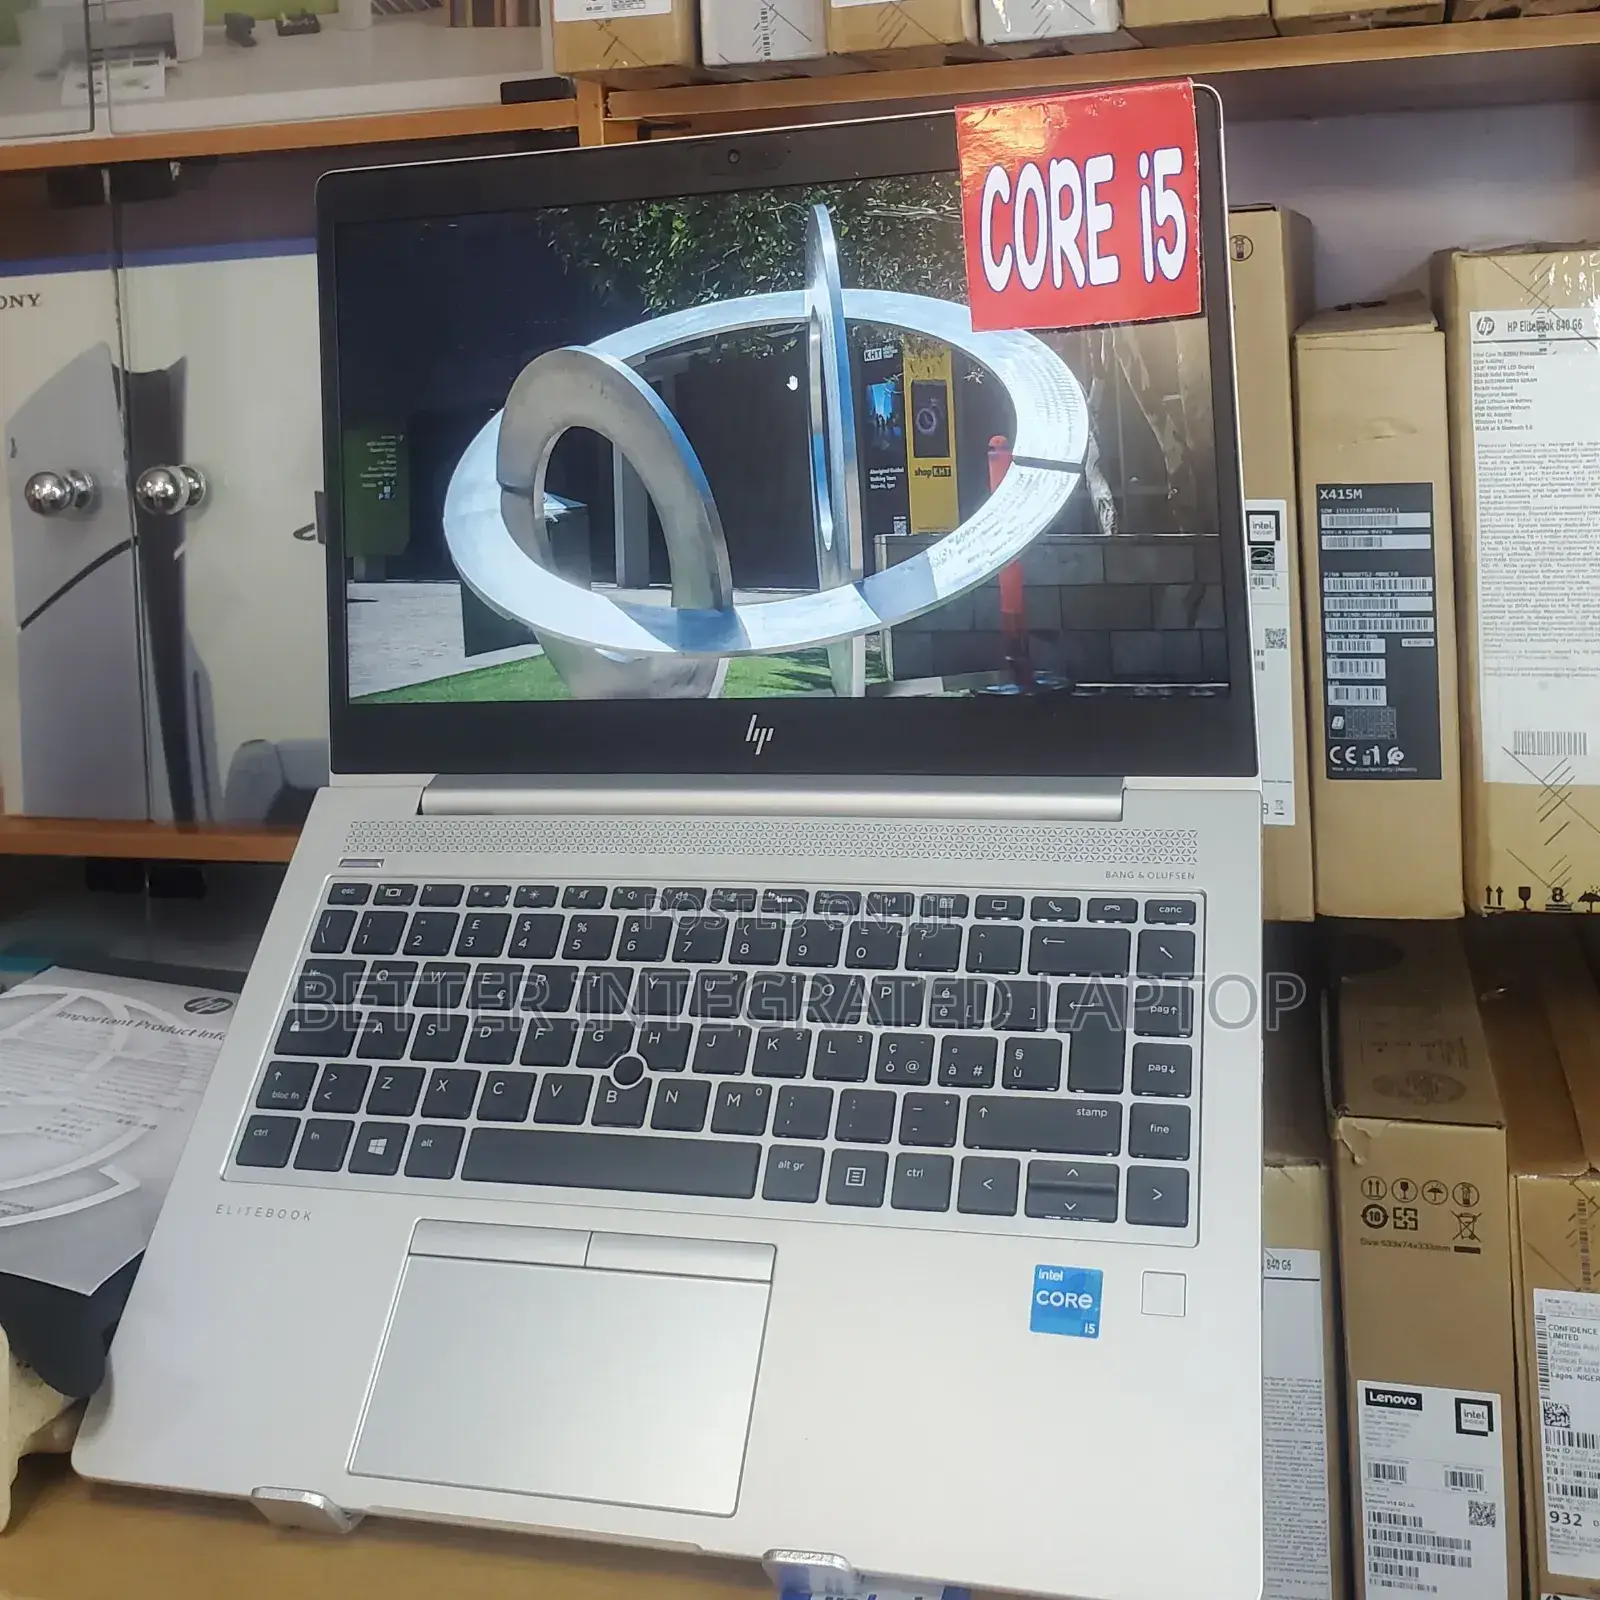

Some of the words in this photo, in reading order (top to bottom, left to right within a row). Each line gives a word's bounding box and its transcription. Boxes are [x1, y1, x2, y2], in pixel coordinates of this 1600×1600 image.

[980, 153, 1119, 292] CORE
[1138, 147, 1187, 283] i5
[1507, 321, 1518, 332] HP
[1556, 320, 1570, 331] 840
[1572, 319, 1583, 331] G6
[1320, 489, 1362, 500] X415M
[1105, 871, 1136, 879] BANG
[1138, 871, 1145, 879] &
[1147, 871, 1195, 880] OLUFSEN
[1159, 906, 1182, 914] canc
[362, 934, 368, 944] 1
[412, 936, 423, 946] 2
[465, 937, 475, 947] 3
[518, 938, 528, 949] 4
[572, 940, 581, 950] 5
[627, 940, 636, 951] 6
[683, 942, 692, 952] 7
[740, 943, 750, 954] 8
[798, 945, 807, 956] 9
[856, 947, 867, 958] 0
[376, 970, 388, 981] Q
[431, 971, 446, 983] W
[481, 972, 492, 984] E
[535, 975, 547, 987] R
[592, 977, 600, 988] T
[649, 977, 659, 990] Y
[704, 979, 715, 992] U
[762, 981, 767, 993] I
[821, 983, 835, 996] O
[881, 987, 892, 999] P
[942, 988, 951, 999] é
[940, 1005, 948, 1017] è
[56, 1011, 134, 1028] Important
[135, 1019, 196, 1037] Product
[372, 1022, 384, 1034] A
[426, 1024, 437, 1036] S
[480, 1026, 492, 1038] D
[534, 1028, 546, 1040] F
[593, 1029, 604, 1042] G
[648, 1031, 661, 1044] H
[738, 1029, 742, 1037] 1
[707, 1034, 717, 1047] J
[767, 1038, 779, 1050] K
[857, 1035, 864, 1043] 3
[828, 1041, 837, 1053] L
[889, 1043, 897, 1054] ç
[1015, 1048, 1024, 1060] §
[885, 1060, 895, 1072] ò
[905, 1060, 919, 1073] @
[949, 1063, 957, 1075] à
[973, 1065, 983, 1076] #
[1013, 1066, 1022, 1079] ù
[271, 1090, 289, 1099] bloc
[290, 1091, 300, 1099] fn
[1076, 1107, 1108, 1118] stamp
[253, 1128, 268, 1137] ctrl
[1150, 1124, 1170, 1134] fine
[311, 1131, 320, 1140] fn
[421, 1138, 433, 1147] alt
[778, 1160, 791, 1169] alt
[793, 1162, 804, 1171] gr
[906, 1168, 924, 1178] ctrl
[216, 1204, 312, 1220] ELITEBOOK
[1267, 1259, 1280, 1270] 840
[1282, 1259, 1292, 1271] G6
[1038, 1268, 1064, 1281] intel
[1084, 1322, 1096, 1334] i5
[1548, 1324, 1598, 1336] CONFIDENCE
[1549, 1332, 1579, 1341] LIMITED
[1370, 1391, 1417, 1405] Lenovo
[1549, 1511, 1582, 1527] 932
